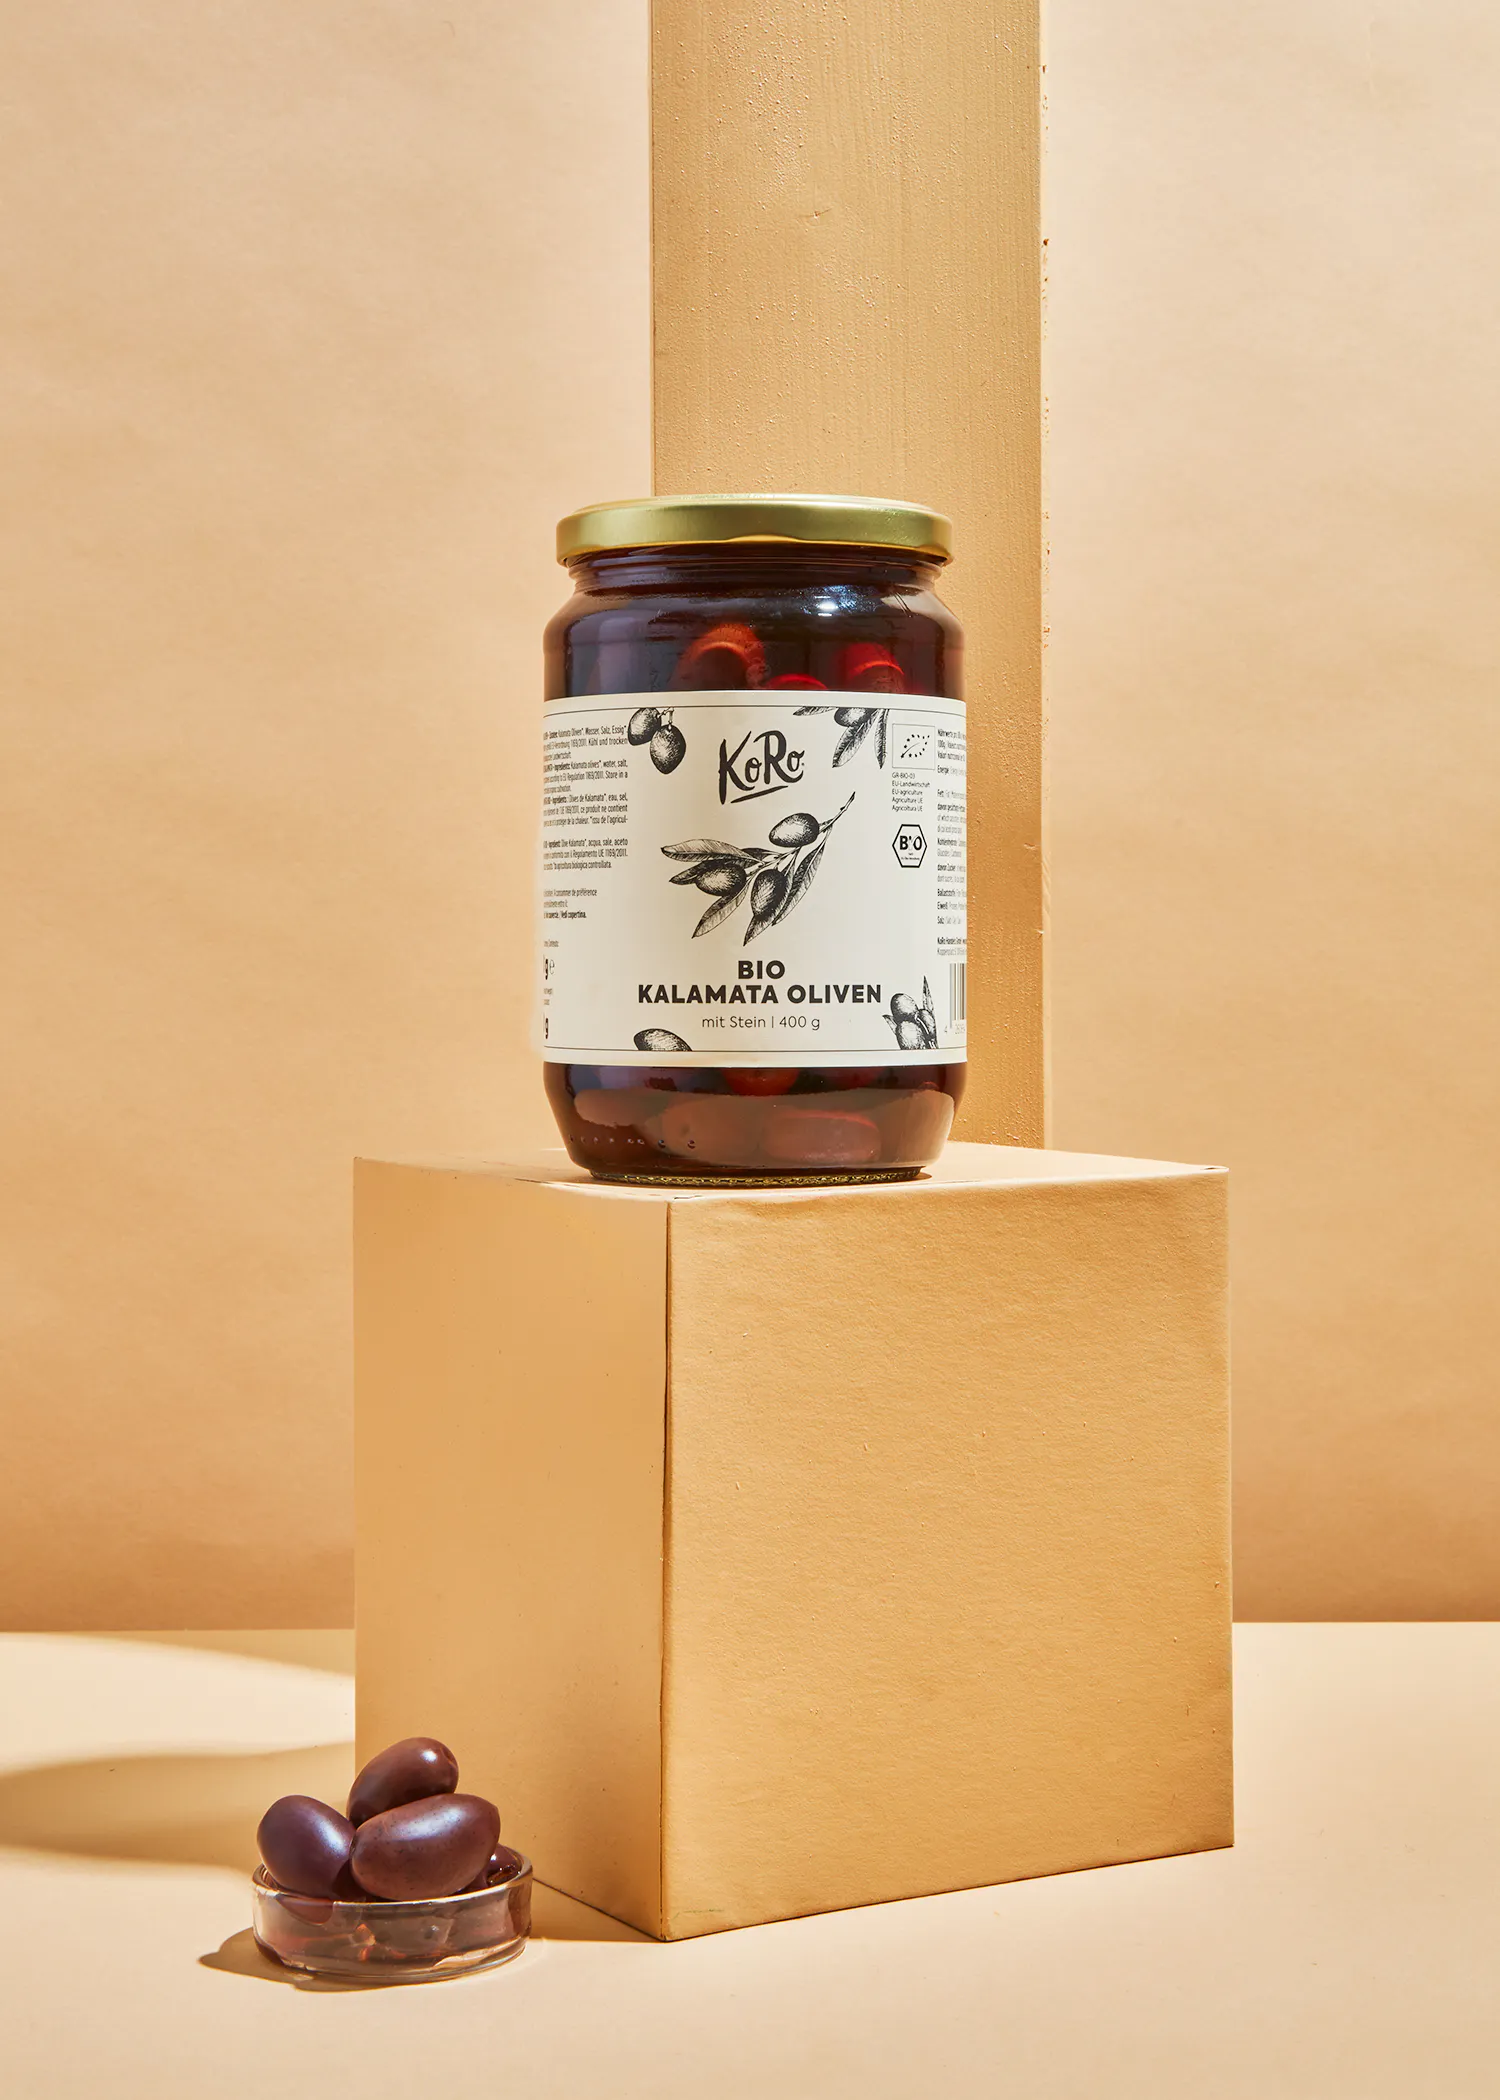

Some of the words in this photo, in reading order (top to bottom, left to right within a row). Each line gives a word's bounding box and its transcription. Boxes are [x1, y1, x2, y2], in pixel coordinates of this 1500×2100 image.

[588, 738, 598, 746] Kühl
[599, 738, 608, 746] und
[609, 738, 628, 746] trocken
[718, 730, 805, 805] KoRo
[605, 770, 618, 779] Store
[619, 770, 624, 778] in
[586, 805, 600, 814] produit
[608, 804, 628, 812] contient
[601, 816, 607, 824] de
[614, 838, 628, 846] aceto
[598, 849, 605, 857] UE
[737, 960, 786, 980] BIO
[638, 984, 779, 1004] KALAMATA
[787, 984, 881, 1004] OLIVEN
[702, 1015, 726, 1028] mit
[729, 1015, 766, 1029] Stein
[779, 1015, 807, 1029] 400
[811, 1018, 821, 1031] g
